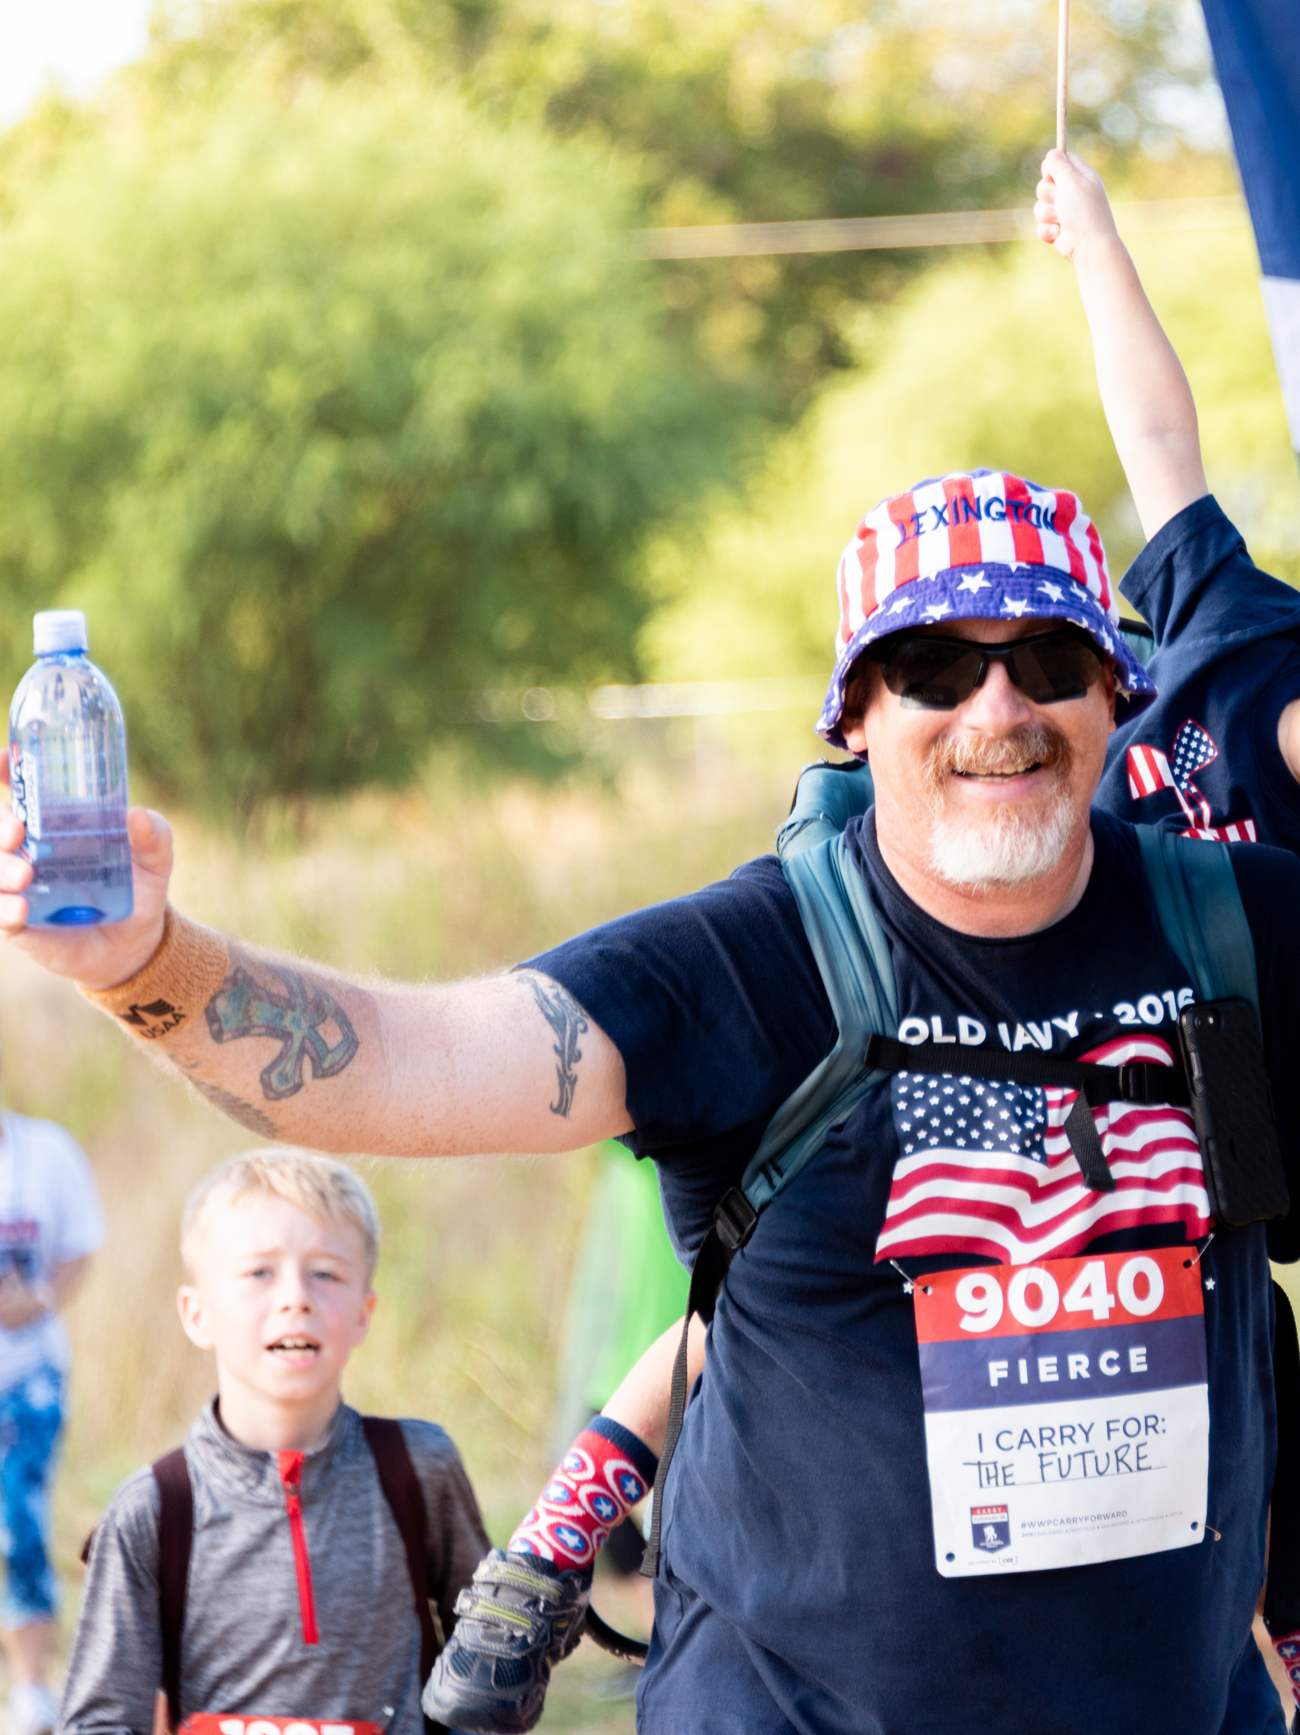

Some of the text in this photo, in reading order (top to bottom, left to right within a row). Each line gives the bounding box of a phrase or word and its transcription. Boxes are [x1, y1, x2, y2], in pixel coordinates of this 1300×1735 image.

[895, 494, 1063, 550] LEXINGTON
[140, 1012, 187, 1039] USAA
[898, 1015, 987, 1046] OLD
[955, 1256, 1165, 1333] 9040
[987, 1346, 1149, 1388] FIERCE
[977, 1414, 1168, 1454] I CARRY FOR:
[963, 1442, 1153, 1488] THE FUTURE
[976, 1507, 1003, 1516] CARRY
[1021, 1510, 1128, 1529] #WWPCARRYFORWARD
